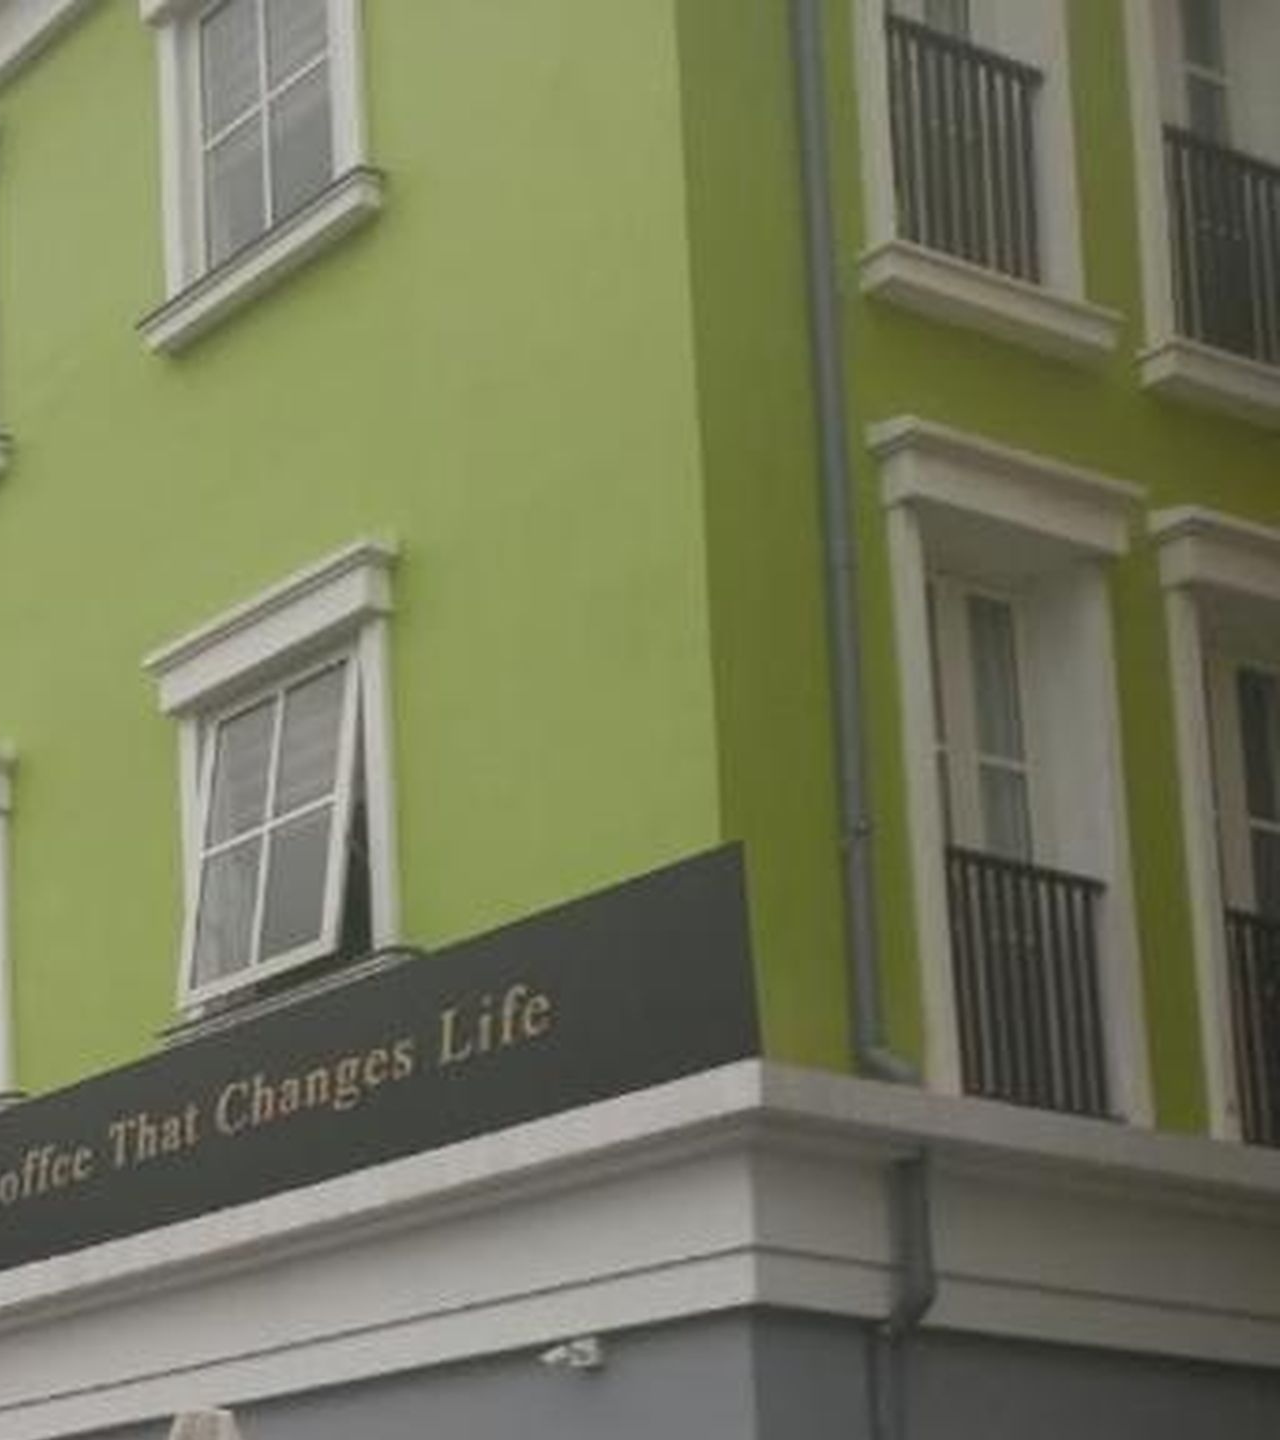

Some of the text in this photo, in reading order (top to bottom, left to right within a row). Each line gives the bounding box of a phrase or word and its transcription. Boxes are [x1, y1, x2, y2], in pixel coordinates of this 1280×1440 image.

[108, 1104, 200, 1168] That
[214, 1034, 417, 1135] Changes
[439, 983, 551, 1066] Life
